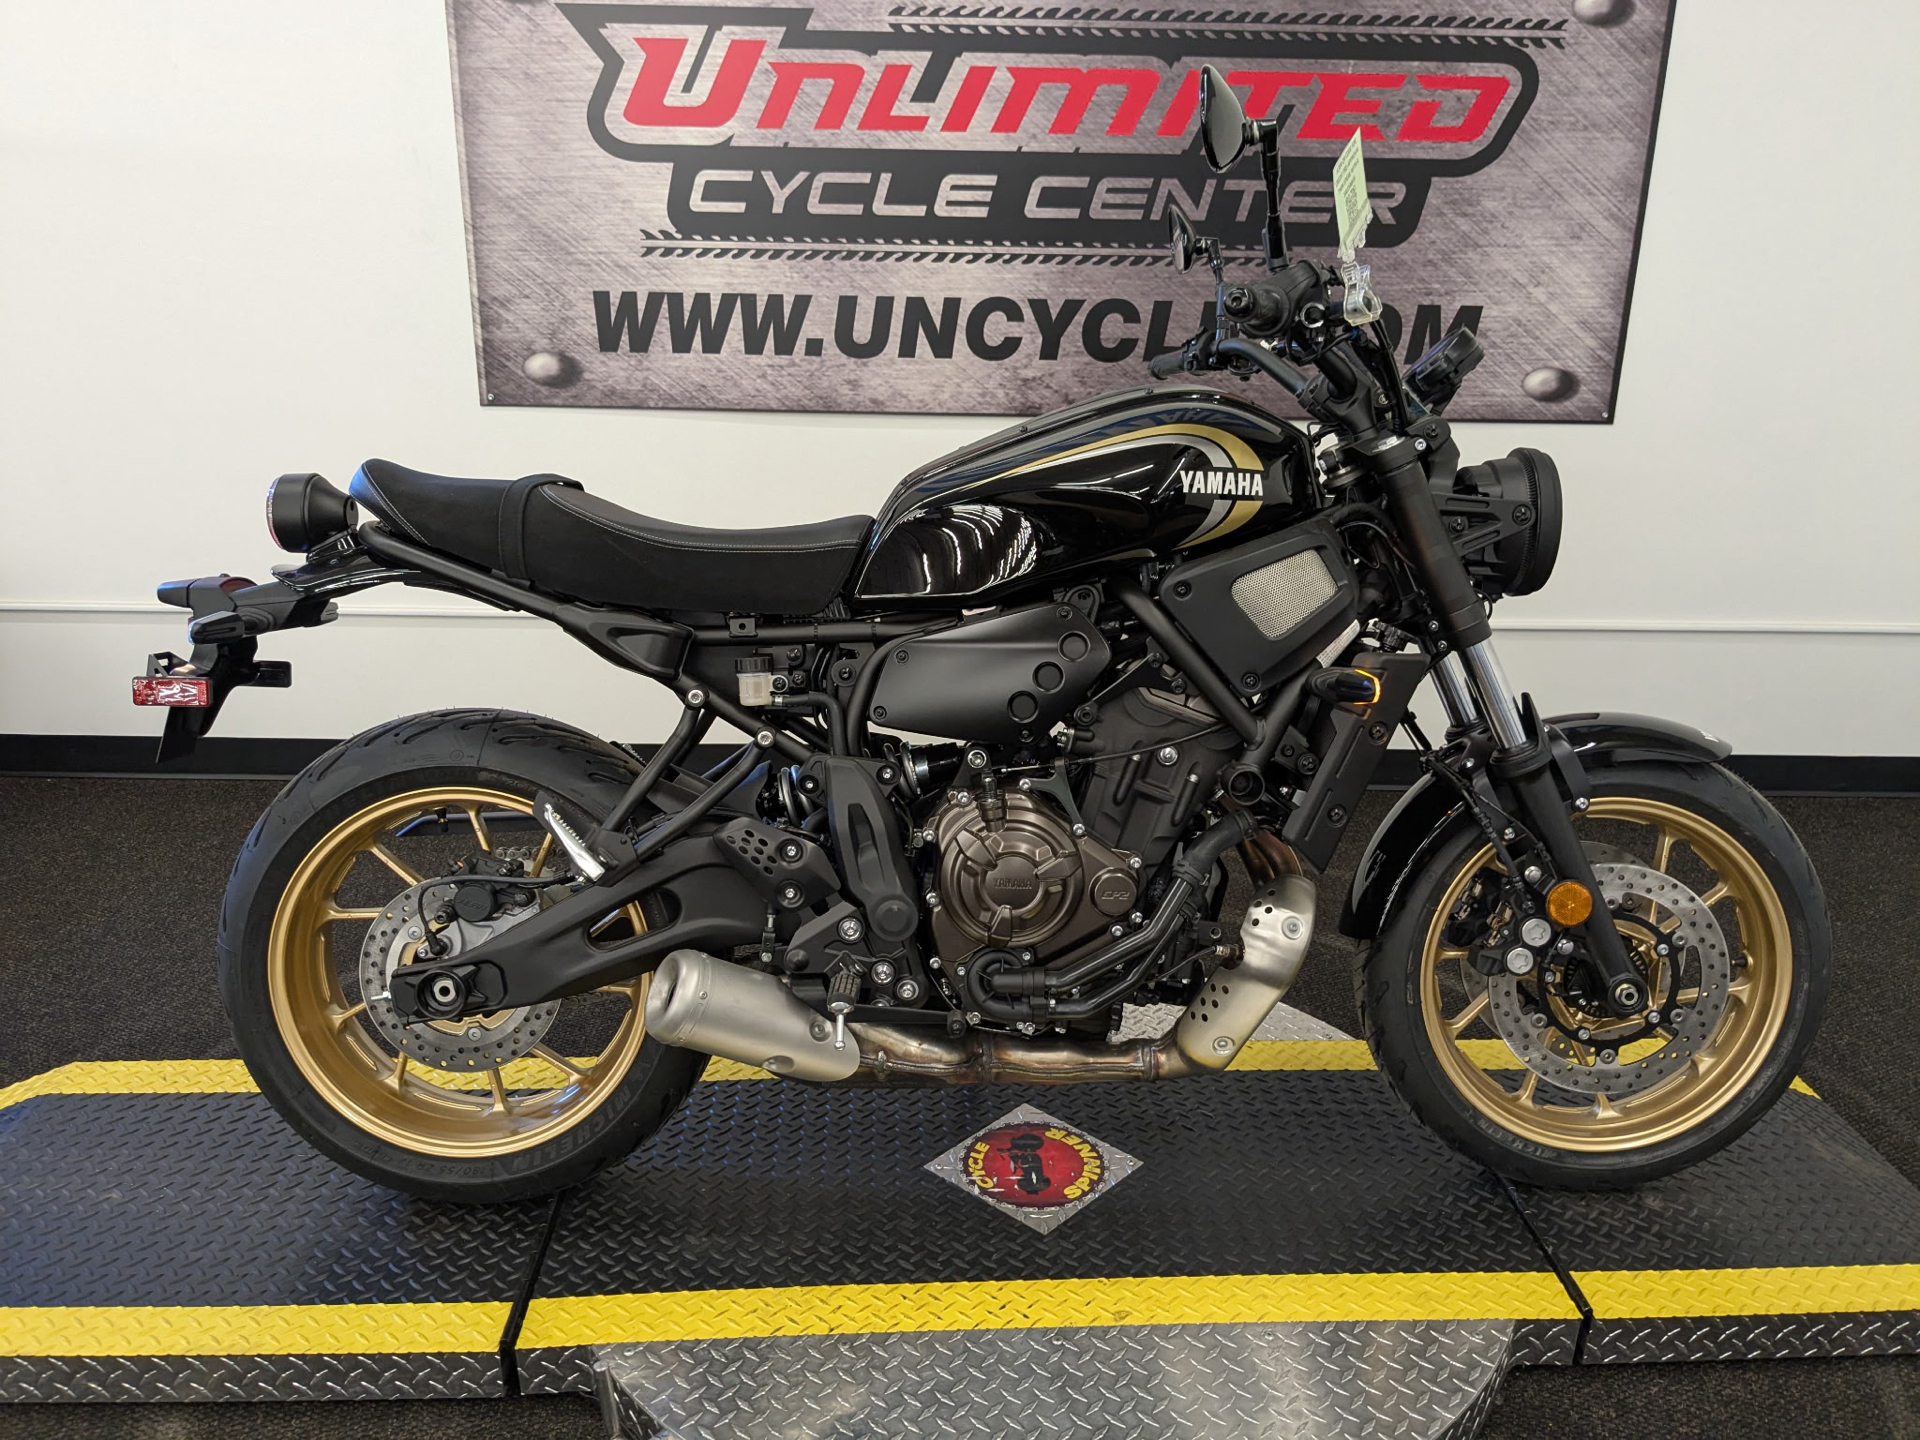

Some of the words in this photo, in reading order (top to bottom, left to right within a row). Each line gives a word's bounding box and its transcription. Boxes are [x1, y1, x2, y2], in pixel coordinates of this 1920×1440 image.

[689, 170, 998, 217] CYCLE
[1024, 175, 1407, 224] CENTER
[1180, 470, 1264, 497] YAMAHA
[993, 877, 1032, 889] YAMAHA
[510, 1084, 632, 1173] MICHELIN
[967, 1141, 995, 1189] CYCLE
[1044, 1127, 1101, 1199] SPINNER
